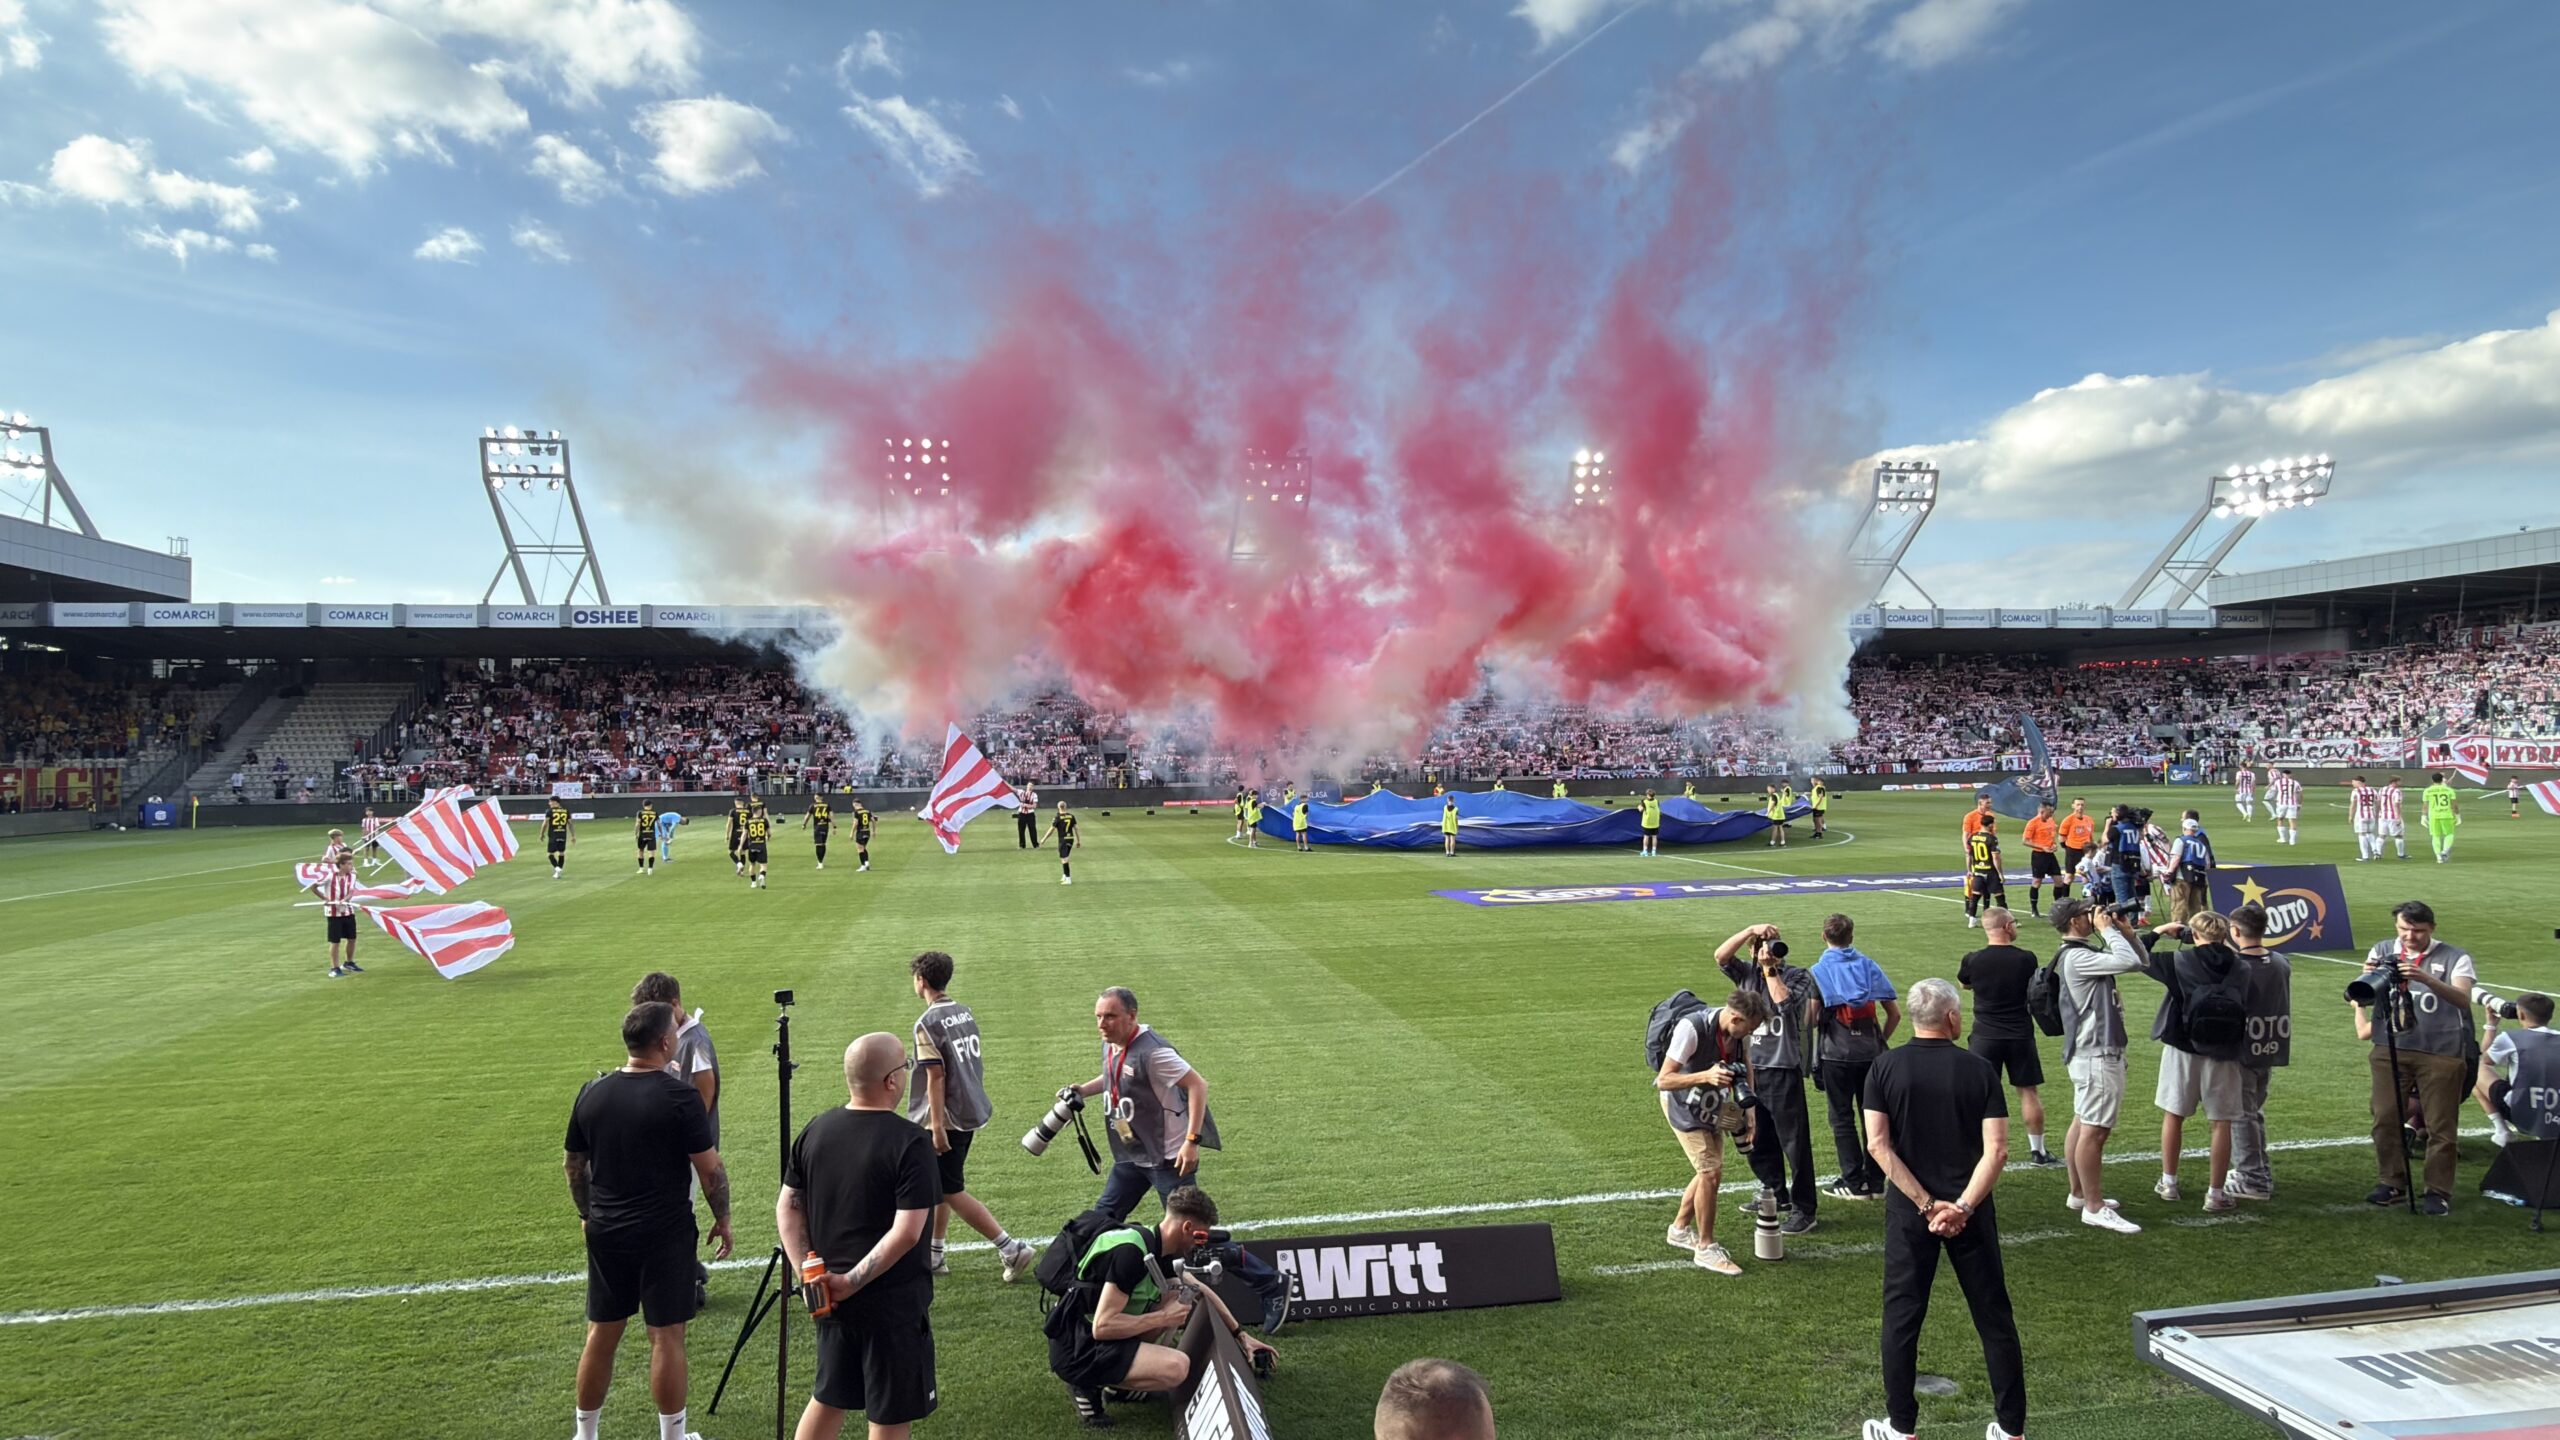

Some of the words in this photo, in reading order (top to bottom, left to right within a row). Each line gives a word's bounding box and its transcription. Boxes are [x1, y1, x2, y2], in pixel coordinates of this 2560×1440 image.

[62, 611, 127, 619] www.comarch.pl
[153, 610, 215, 620] COMARCH
[242, 611, 303, 619] www.comarch.pl
[328, 611, 388, 621] COMARCH
[497, 611, 554, 621] COMARCH
[573, 610, 639, 624] OSHEE
[659, 611, 715, 621] COMARCH
[1887, 615, 1928, 623] COMARCH
[2113, 615, 2152, 623] COMARCH
[2221, 615, 2259, 623] COMARCH
[1744, 764, 1782, 773] CRACOVIA
[2433, 794, 2449, 807] 13
[552, 812, 567, 825] 23
[739, 813, 747, 825] 6
[814, 807, 828, 819] 44
[862, 813, 868, 826] 8
[641, 814, 656, 827] 37
[1064, 819, 1071, 833] 7
[750, 822, 765, 837] 88
[2123, 829, 2139, 844] TV
[1971, 842, 1989, 861] 10
[2186, 839, 2206, 859] TV
[2246, 1014, 2290, 1040] OTO
[952, 1033, 981, 1063] FTO
[2251, 1041, 2279, 1056] 049
[1290, 1302, 1376, 1316] SOTONIC
[1391, 1299, 1449, 1310] DRINK
